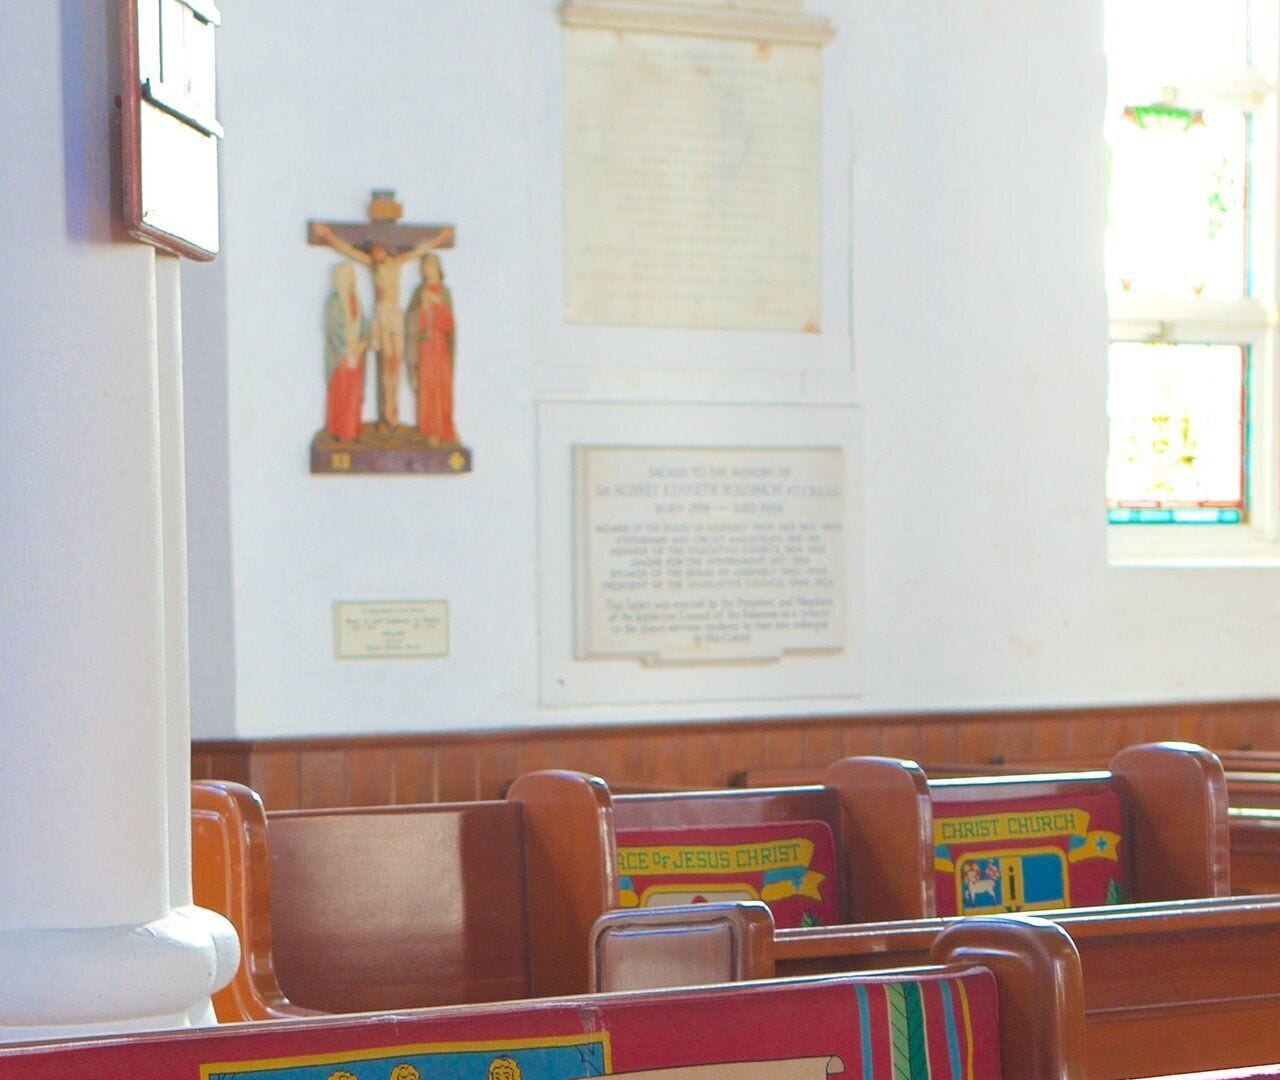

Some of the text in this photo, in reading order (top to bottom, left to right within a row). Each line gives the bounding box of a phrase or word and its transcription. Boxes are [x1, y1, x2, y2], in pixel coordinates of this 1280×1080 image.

[941, 813, 1076, 840] CHRIST CHURCH
[672, 850, 731, 870] JESUS
[735, 843, 801, 868] CHRIST
